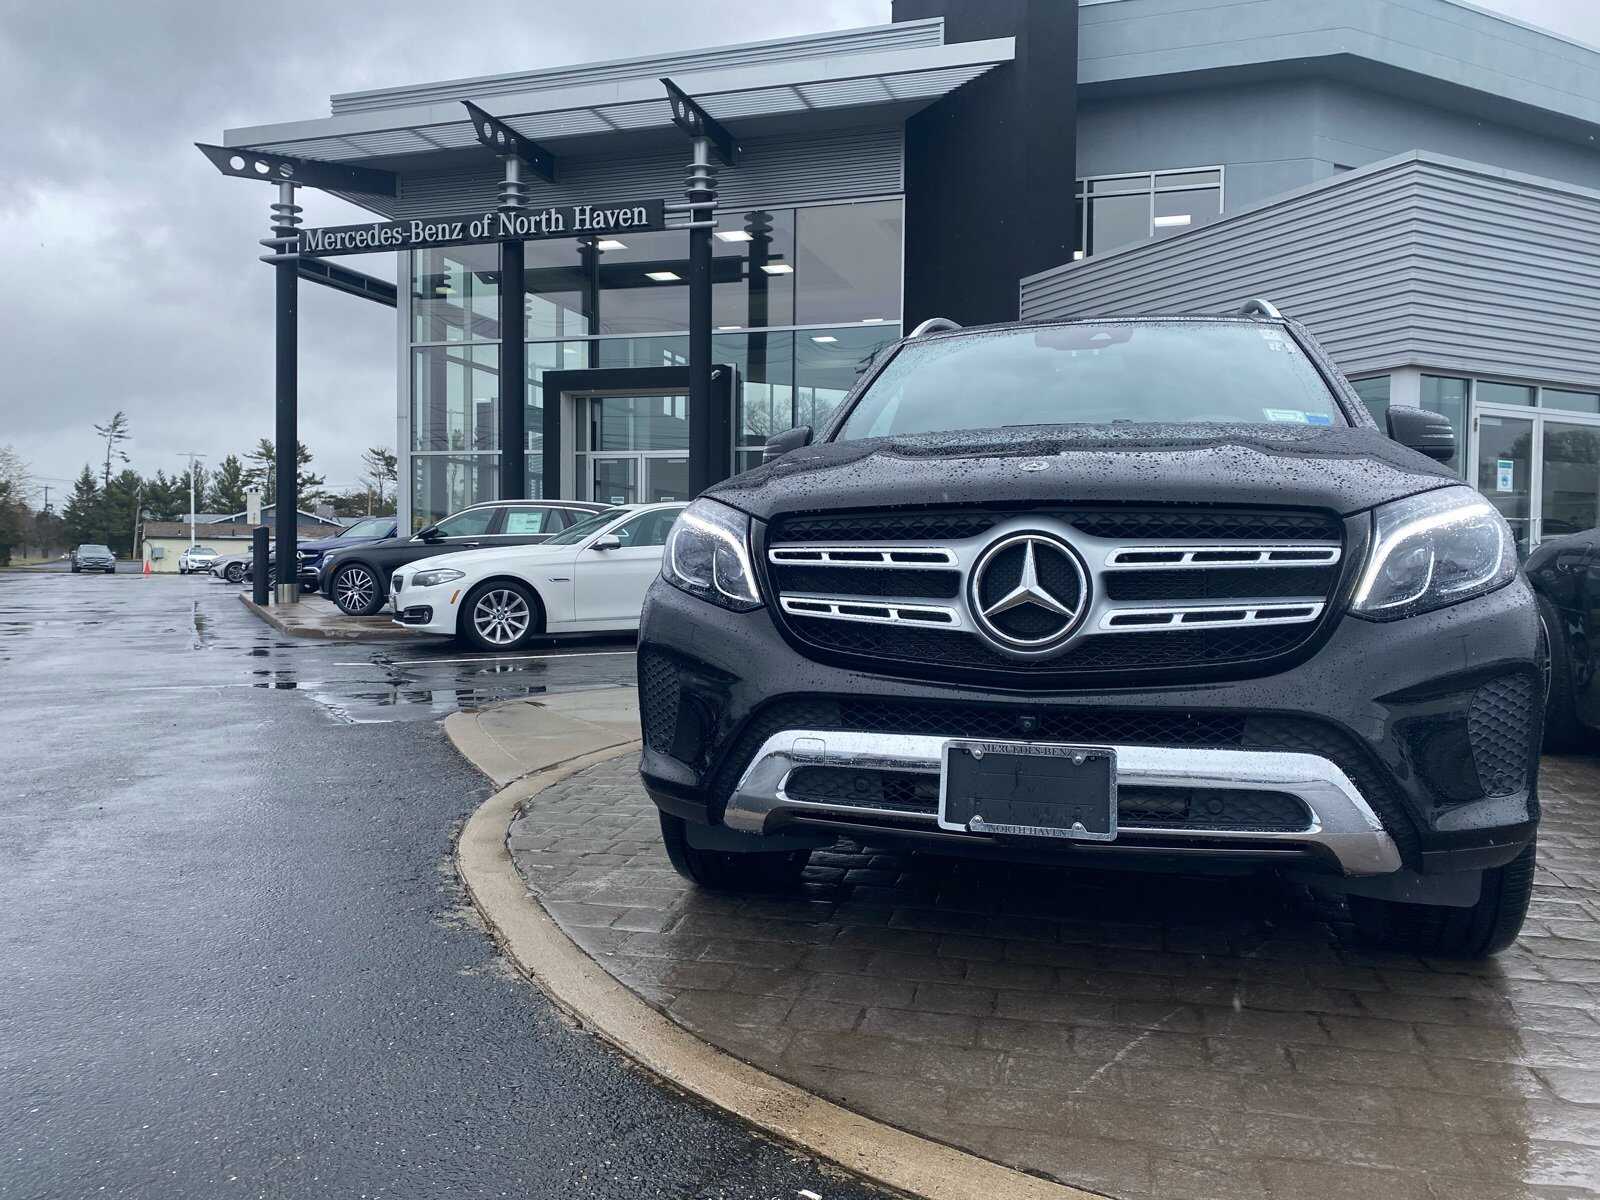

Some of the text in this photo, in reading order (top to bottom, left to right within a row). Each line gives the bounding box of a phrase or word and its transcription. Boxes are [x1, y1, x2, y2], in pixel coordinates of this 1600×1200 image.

[304, 203, 648, 252] Mercedes-Benz of North Haven
[982, 743, 1073, 758] MERCEDES-BENZ
[988, 825, 1067, 838] NORTH HAVEN
